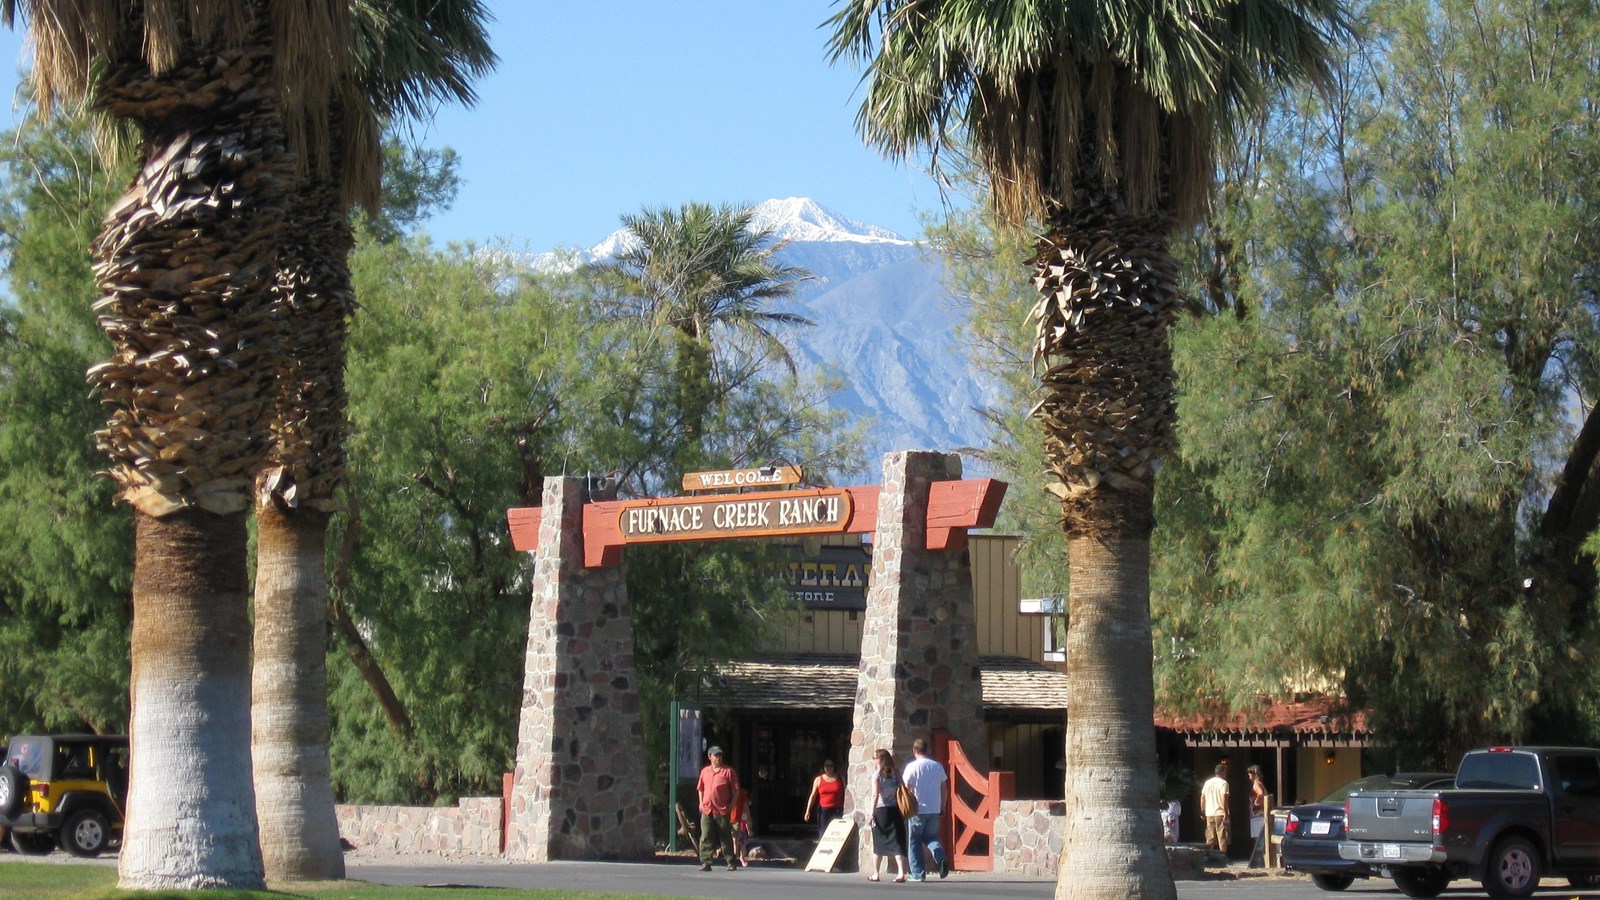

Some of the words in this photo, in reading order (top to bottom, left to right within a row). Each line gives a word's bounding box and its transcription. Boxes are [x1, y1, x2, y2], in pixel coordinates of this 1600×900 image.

[699, 469, 782, 487] WELCOME
[628, 505, 704, 534] FURNACE
[713, 501, 771, 530] CREEK
[779, 497, 839, 527] RANCH
[758, 562, 872, 587] NERA
